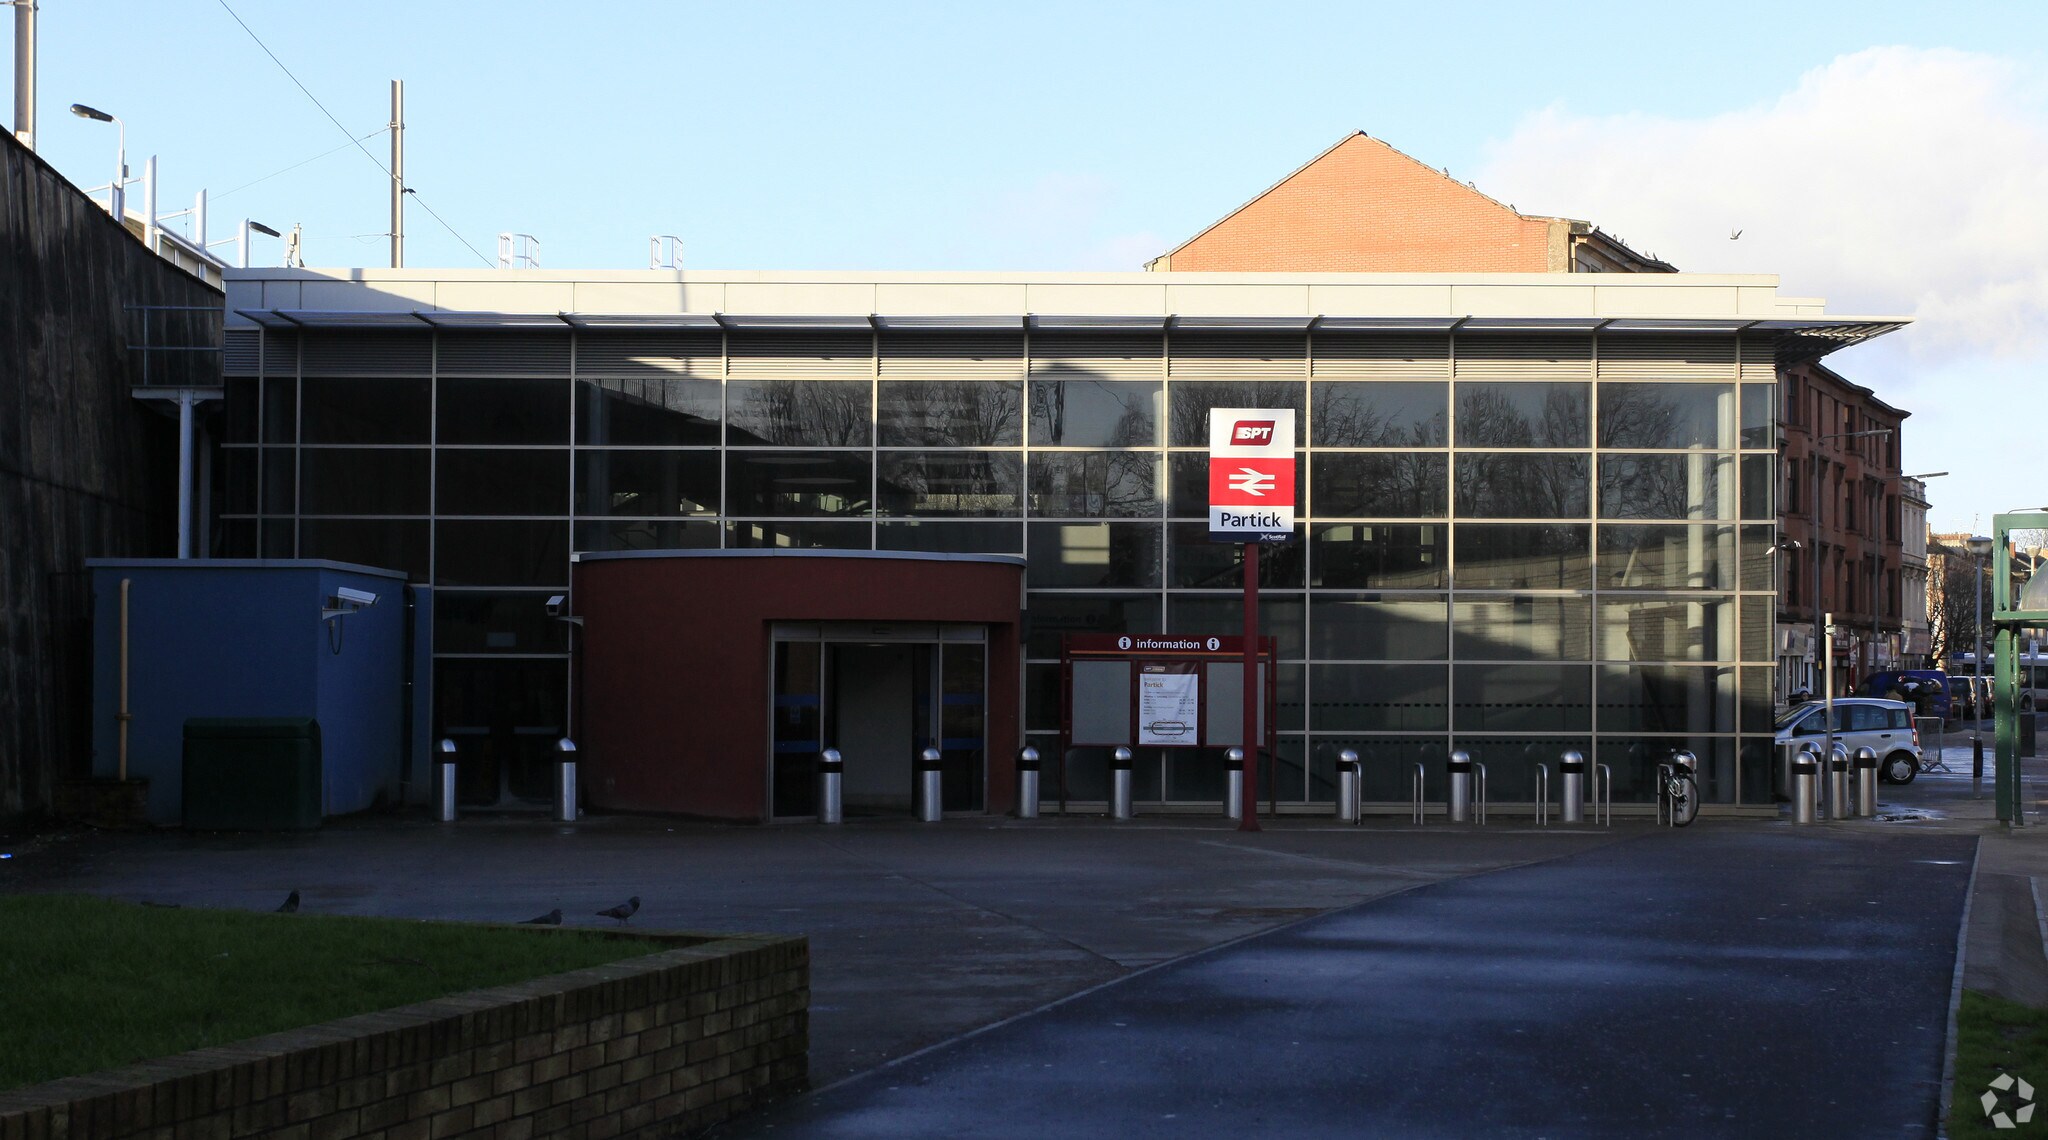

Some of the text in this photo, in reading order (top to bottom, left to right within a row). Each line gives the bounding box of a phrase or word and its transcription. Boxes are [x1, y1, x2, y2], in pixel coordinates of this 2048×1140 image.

[1236, 427, 1272, 439] SPT
[1221, 512, 1281, 527] Partick
[1136, 639, 1200, 649] information
